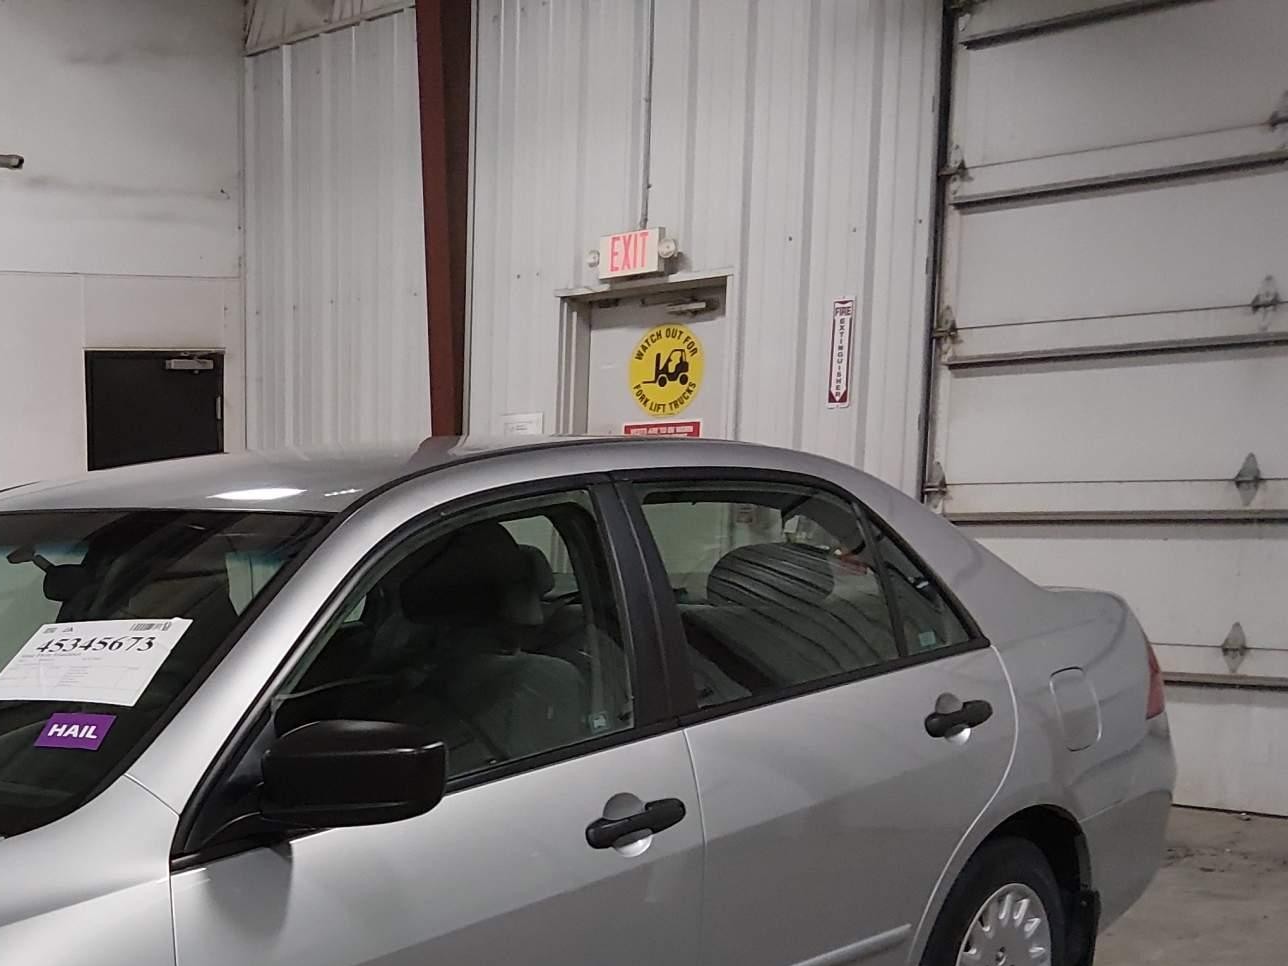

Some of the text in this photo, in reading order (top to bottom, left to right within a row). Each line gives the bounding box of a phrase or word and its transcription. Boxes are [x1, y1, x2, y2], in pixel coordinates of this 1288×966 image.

[610, 231, 649, 272] EXIT
[835, 306, 852, 316] FIRE
[634, 327, 698, 361] WATCH OUT FOR
[835, 317, 846, 397] EXTINGUISHER
[633, 381, 697, 413] FORK LIFT TRUCKS
[37, 636, 156, 653] 45345673
[47, 724, 98, 739] HAIL
